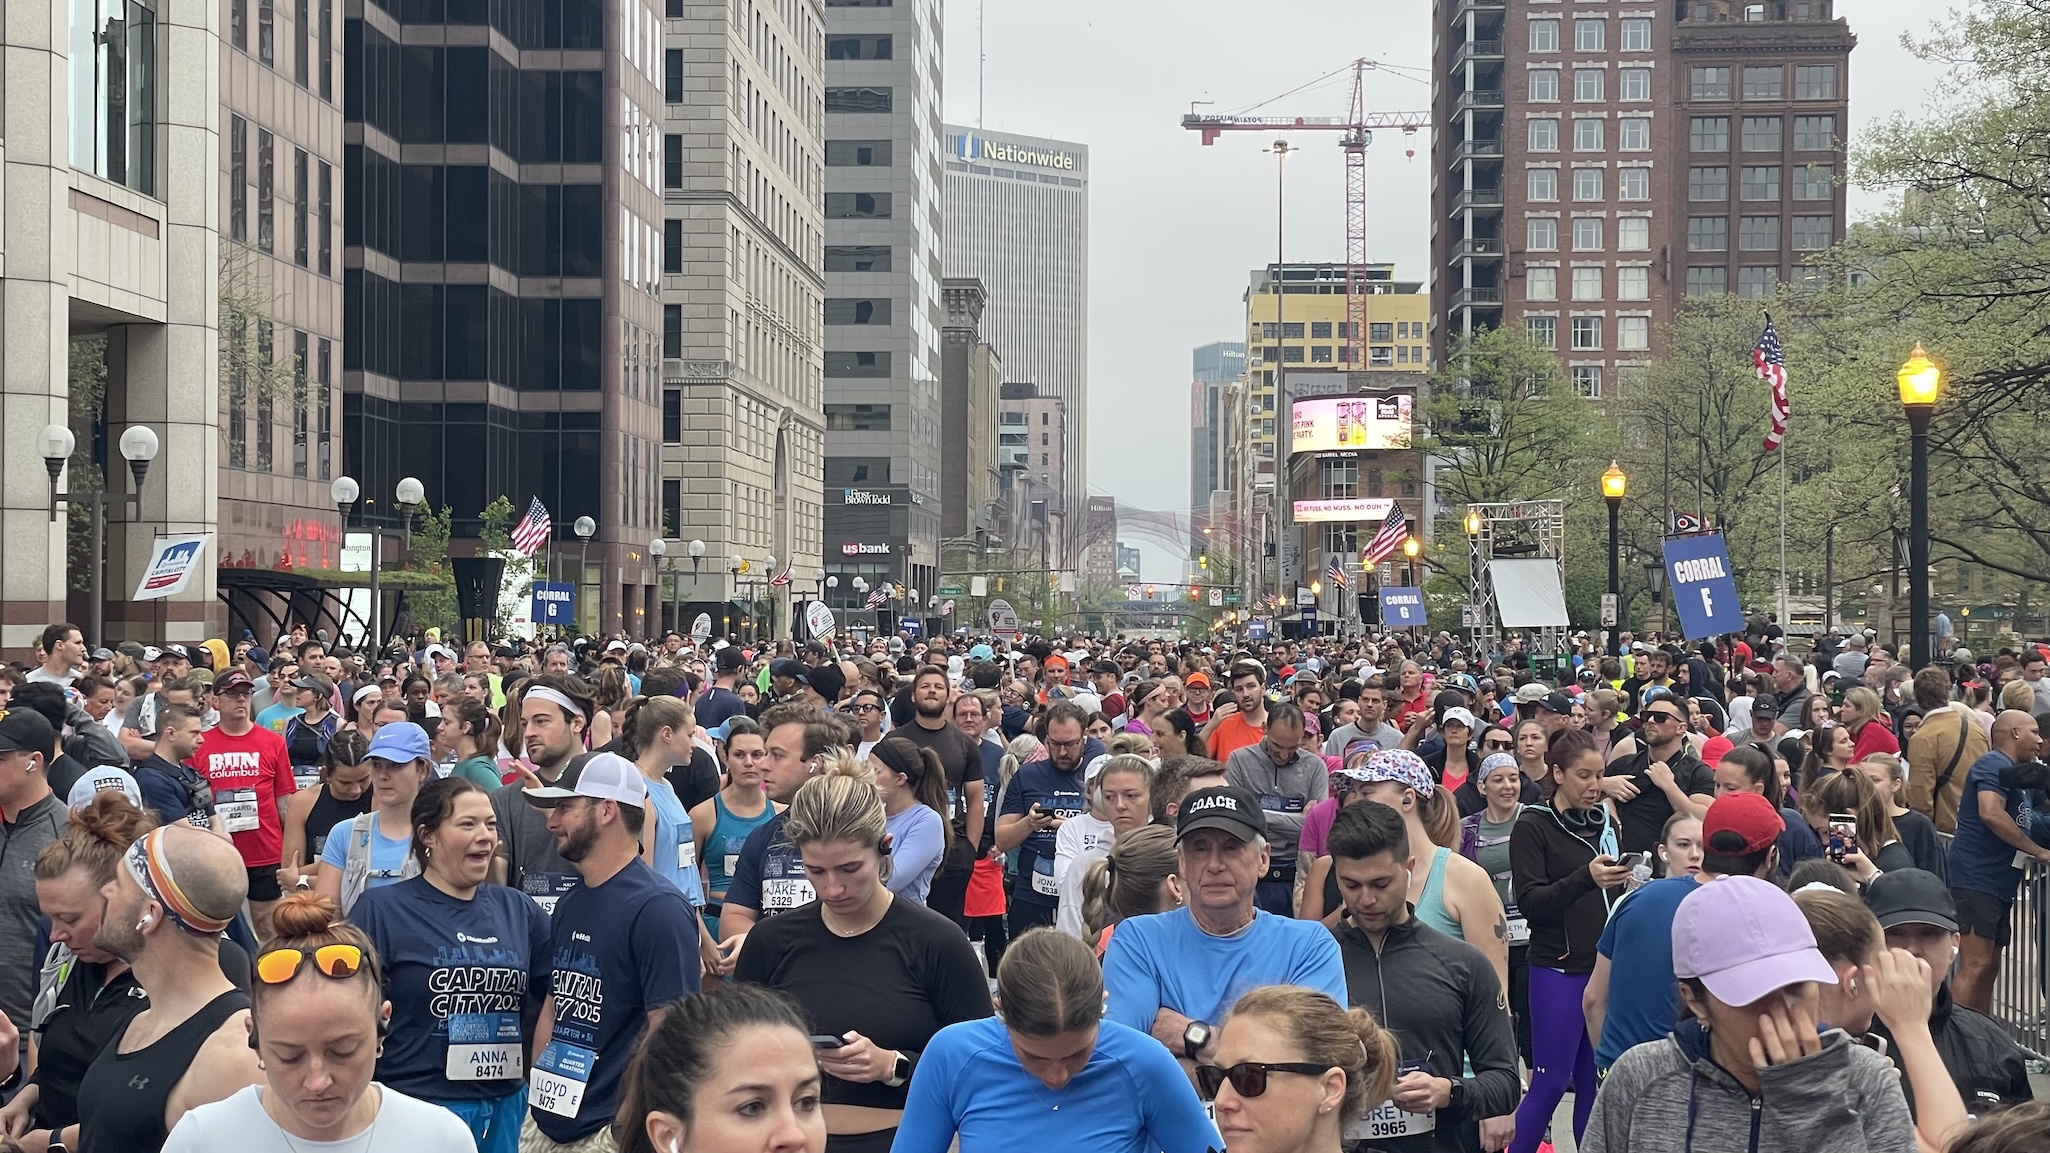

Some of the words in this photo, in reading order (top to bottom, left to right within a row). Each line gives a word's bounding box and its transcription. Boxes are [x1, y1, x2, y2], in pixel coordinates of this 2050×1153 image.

[984, 140, 1073, 170] Nationwide
[1223, 350, 1245, 358] Hilton
[1301, 420, 1315, 429] PINK
[845, 495, 870, 504] Brown
[870, 494, 890, 504] Todd
[345, 545, 370, 553] tington
[152, 568, 173, 576] CAPITAL
[1674, 556, 1726, 584] CORRAL
[537, 590, 570, 601] CORRAL
[1385, 595, 1419, 605] CORRAL
[1700, 587, 1713, 617] F
[548, 603, 557, 617] G
[1400, 606, 1409, 619] G
[209, 752, 260, 771] RUN
[210, 765, 259, 779] columbus
[220, 805, 251, 813] RICHARD
[1189, 795, 1237, 814] COACH
[768, 885, 796, 895] JAKE
[808, 891, 813, 899] E
[771, 897, 792, 906] 5329
[429, 967, 527, 995] CAPITAL
[430, 993, 494, 1019] CITY
[572, 1000, 601, 1024] 2025
[554, 1025, 580, 1040] UARTER
[470, 1051, 508, 1064] ANNA
[517, 1057, 520, 1066] E
[562, 1058, 585, 1068] QUARTER
[476, 1066, 503, 1077] 8474
[559, 1063, 585, 1075] MARATHON
[536, 1077, 567, 1097] LLOYD
[572, 1095, 578, 1105] E
[538, 1093, 556, 1110] 8475
[1372, 1121, 1407, 1136] 3965
